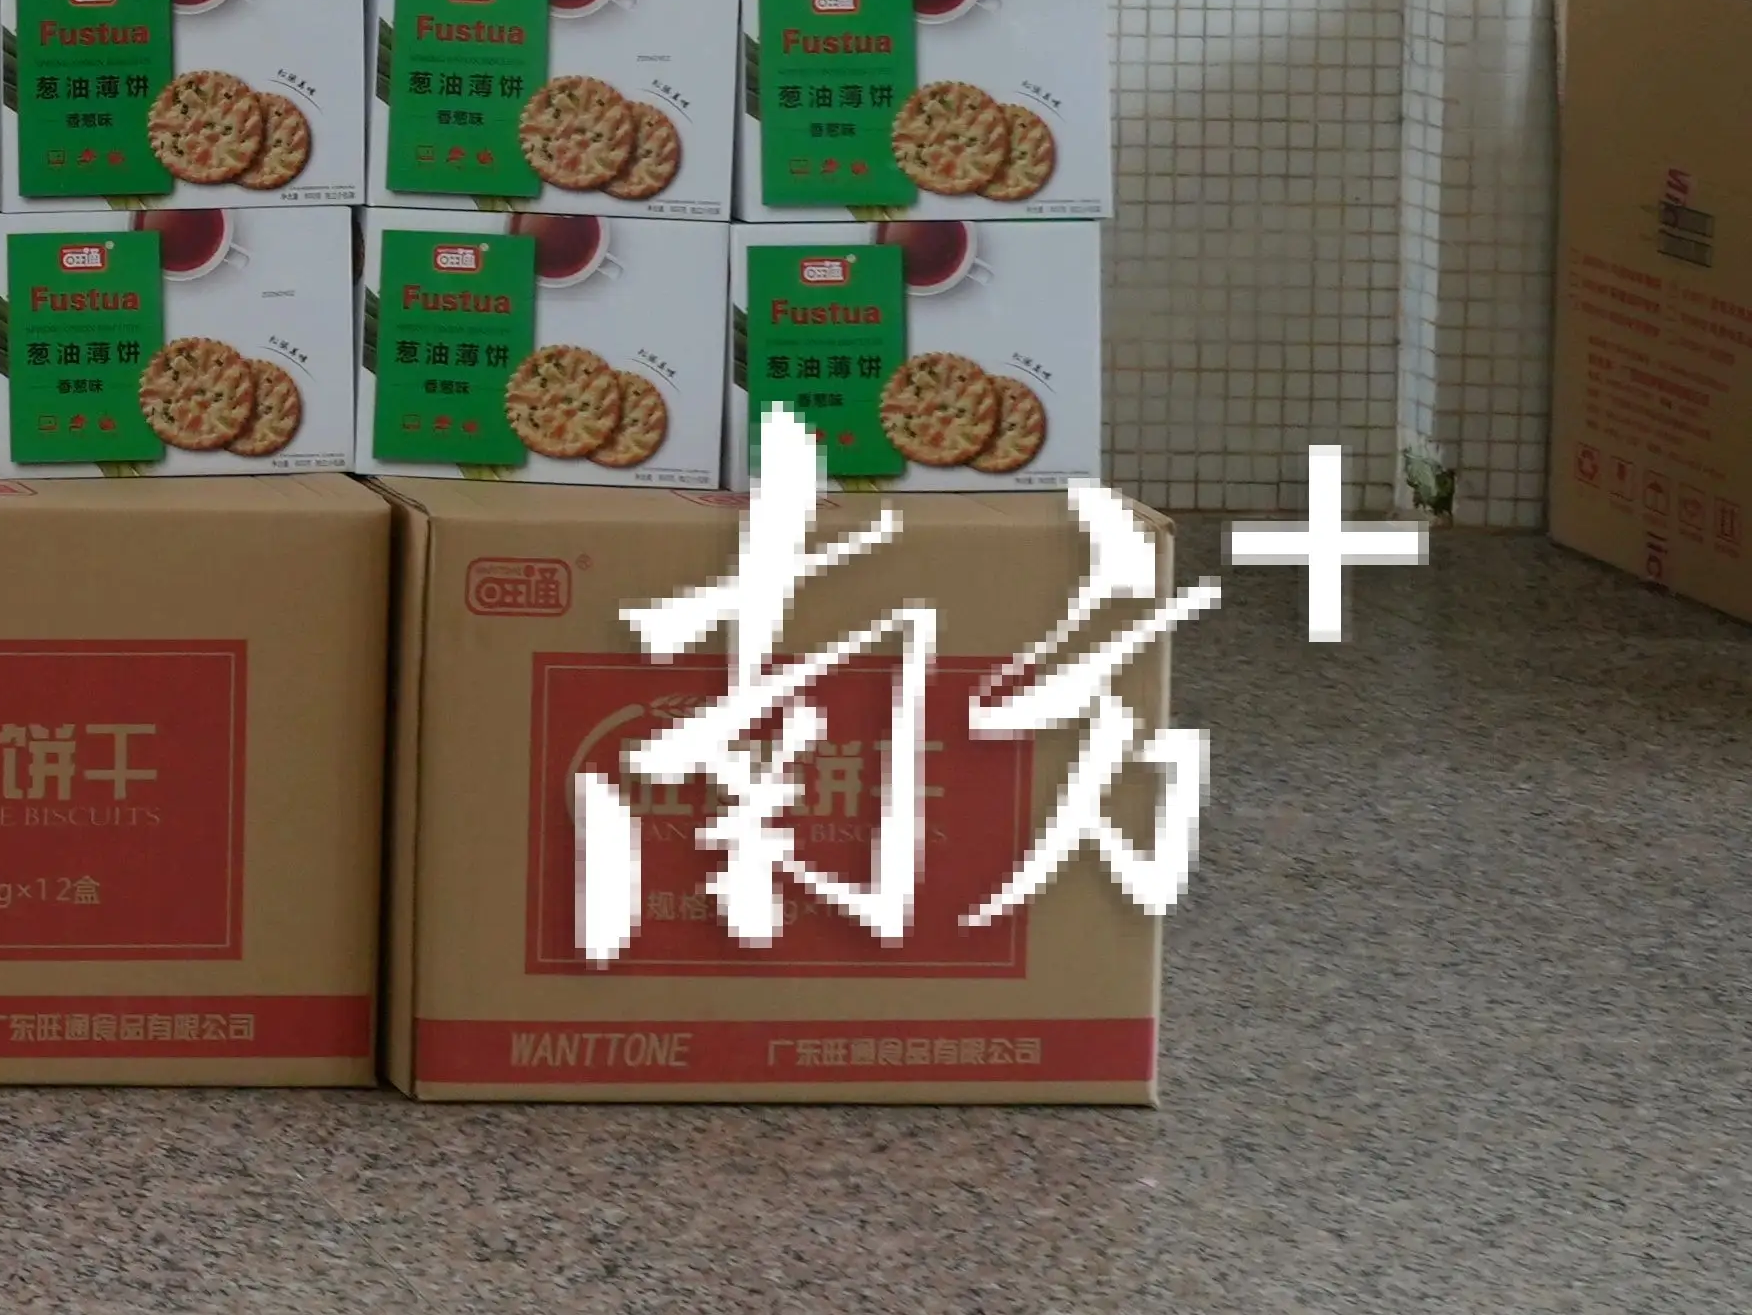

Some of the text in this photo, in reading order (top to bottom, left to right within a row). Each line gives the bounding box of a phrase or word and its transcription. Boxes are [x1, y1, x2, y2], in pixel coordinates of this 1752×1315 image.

[40, 18, 149, 47] Fustua
[416, 15, 526, 45] Fustua
[782, 26, 892, 56] Fustua
[36, 73, 150, 102] 葱油薄饼
[409, 70, 523, 99] 葱油薄饼
[778, 82, 893, 111] 葱油薄饼
[31, 284, 140, 314] Fustua
[402, 284, 512, 314] Fustua
[771, 297, 882, 327] Fustua
[27, 339, 140, 368] 葱油薄饼
[395, 339, 510, 369] 葱油薄饼
[766, 352, 882, 382] 葱油薄饼
[25, 807, 160, 827] BISCUITS
[511, 1033, 692, 1068] WANTTONE
[769, 1038, 1041, 1066] 广东旺通食品有限公司
